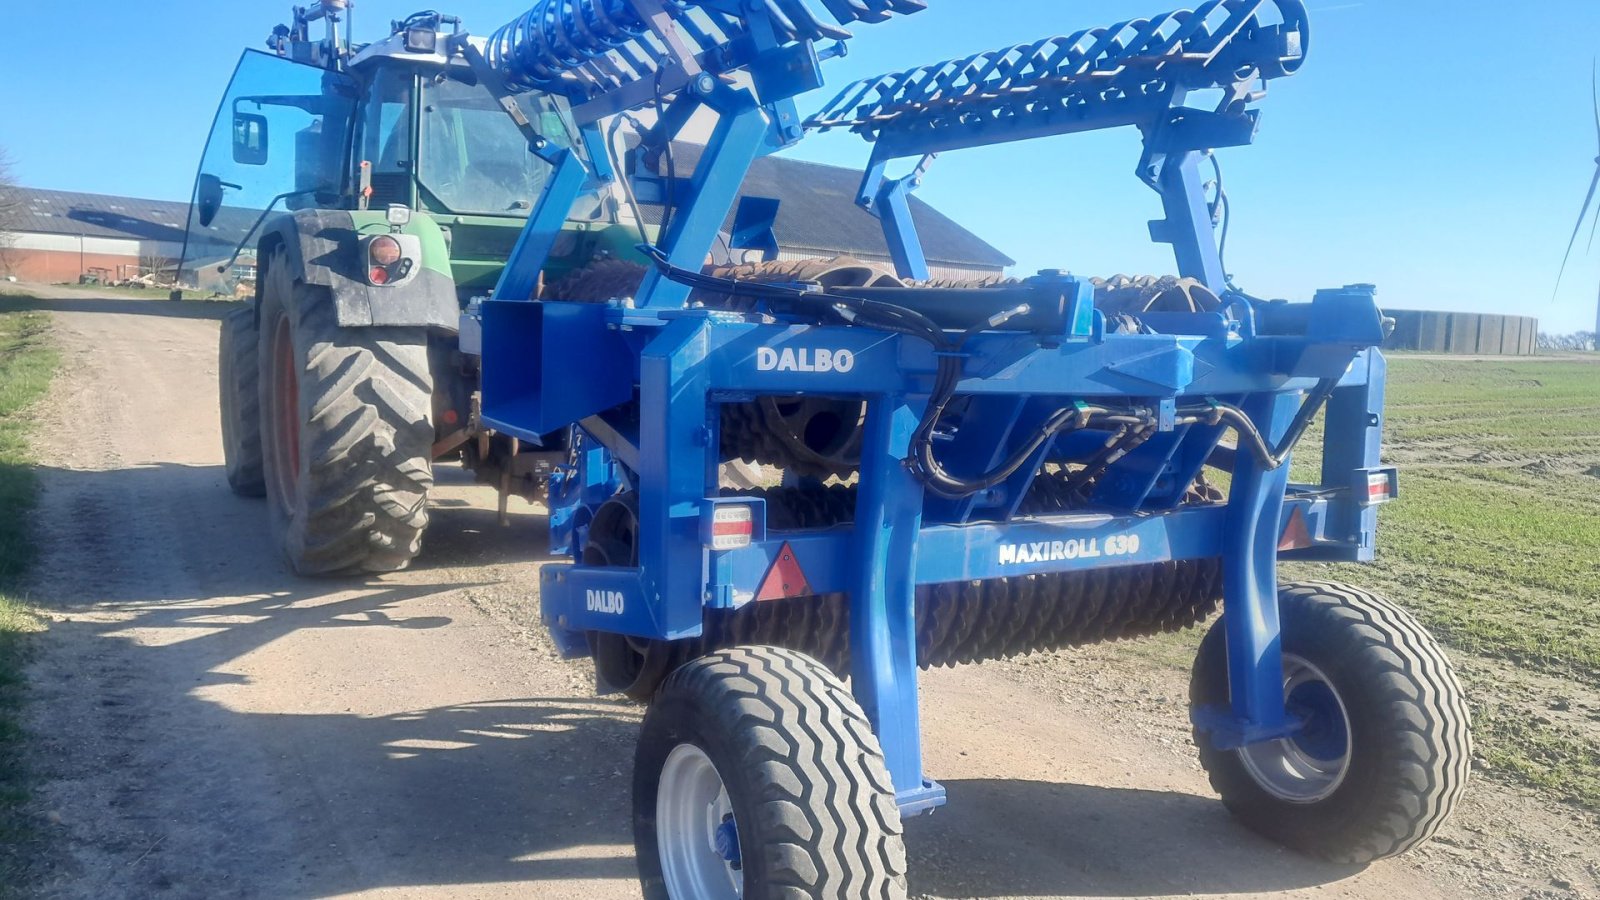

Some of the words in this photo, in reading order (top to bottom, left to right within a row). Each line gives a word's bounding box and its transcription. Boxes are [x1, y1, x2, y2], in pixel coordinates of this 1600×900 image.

[757, 346, 854, 373] DALBO
[999, 537, 1101, 565] MAXIROLL
[1104, 534, 1140, 556] 630
[586, 589, 624, 615] DALBO
